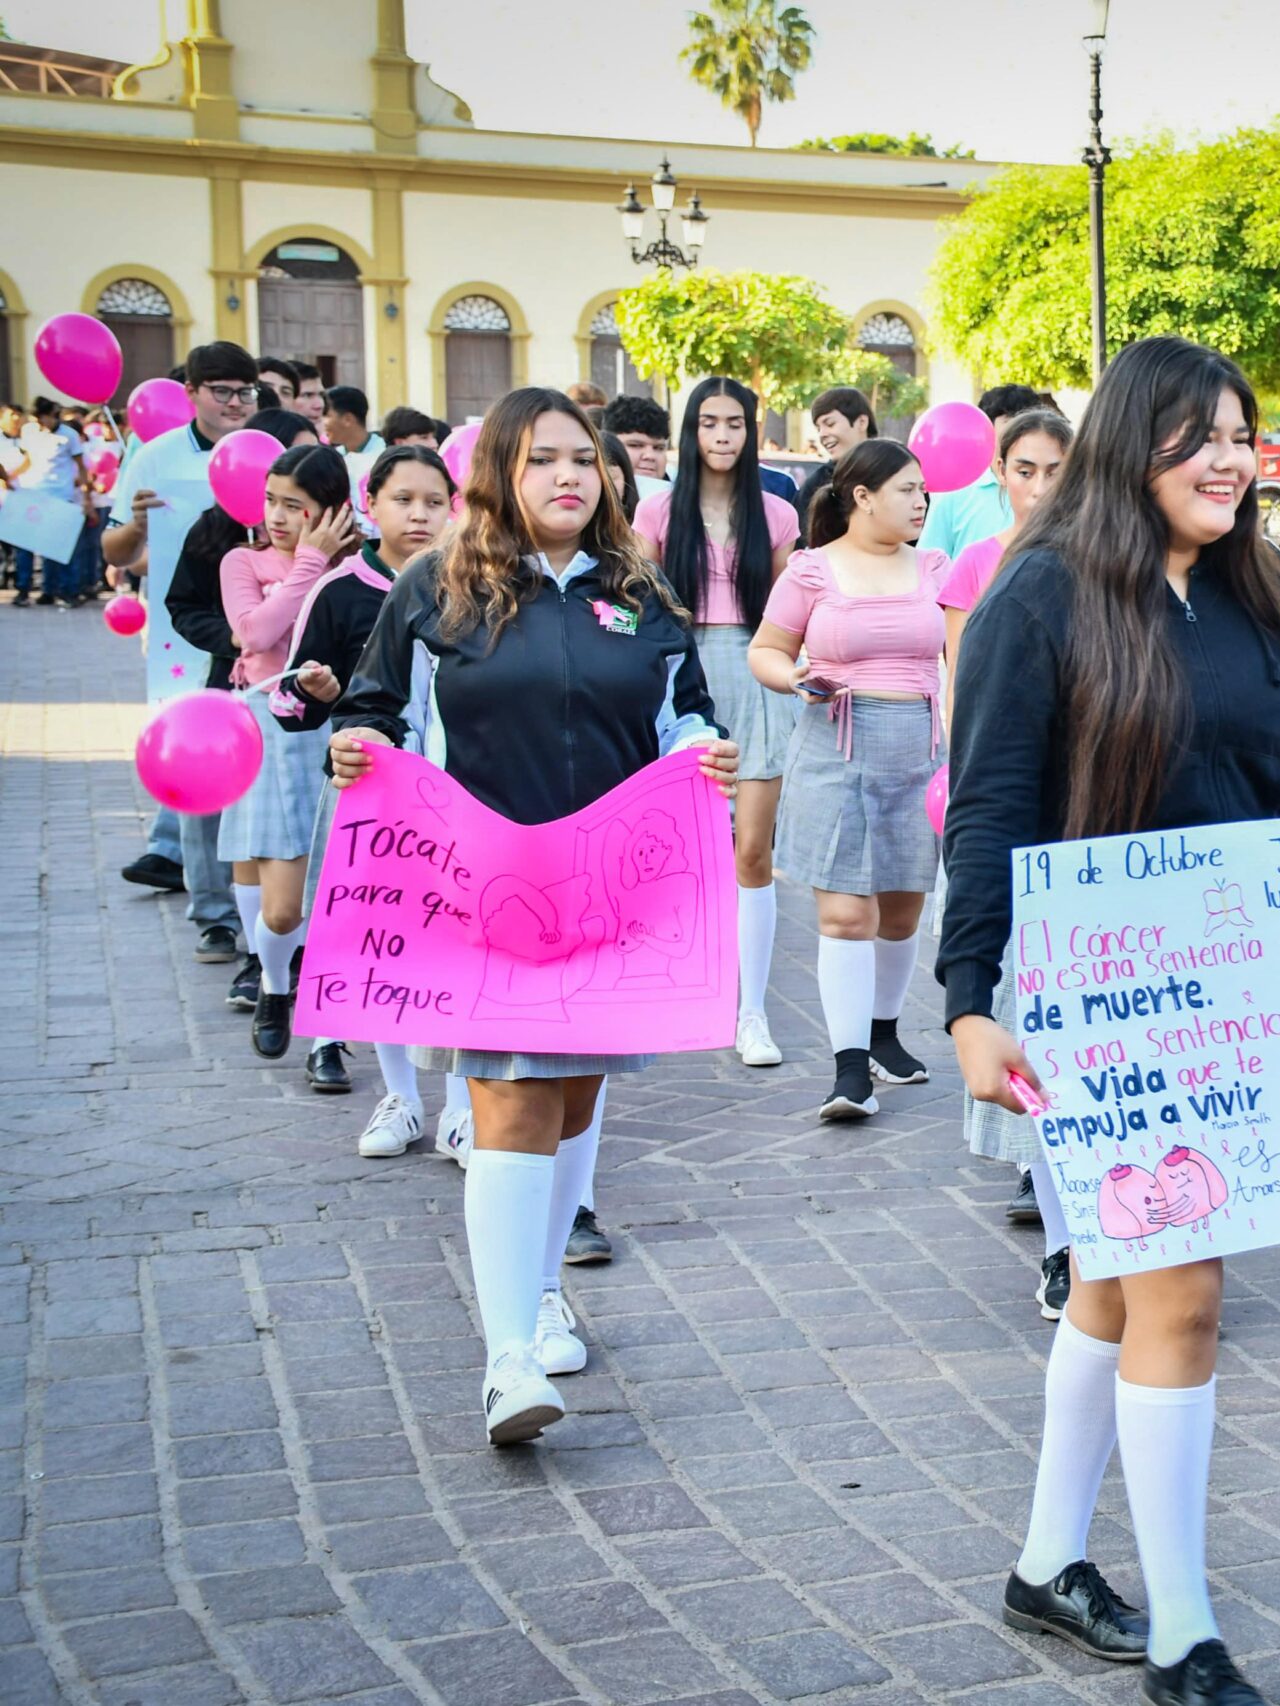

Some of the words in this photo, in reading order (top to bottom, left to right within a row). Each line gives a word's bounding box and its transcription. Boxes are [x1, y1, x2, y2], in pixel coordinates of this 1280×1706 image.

[1019, 850, 1051, 897] 19
[1077, 846, 1103, 885] de
[1125, 835, 1224, 879] Octubre
[326, 881, 404, 917] para
[421, 891, 475, 930] que
[1019, 919, 1053, 967] El
[307, 972, 350, 1012] Te
[361, 966, 454, 1025] toque
[1092, 958, 1135, 984] una
[1023, 994, 1064, 1034] de
[1081, 975, 1214, 1025] muerte.
[1074, 1038, 1127, 1070] una
[1177, 1060, 1223, 1095] que
[1236, 1047, 1265, 1074] te
[1041, 1100, 1148, 1148] empuja
[1160, 1103, 1182, 1124] a
[1187, 1080, 1263, 1122] vivir
